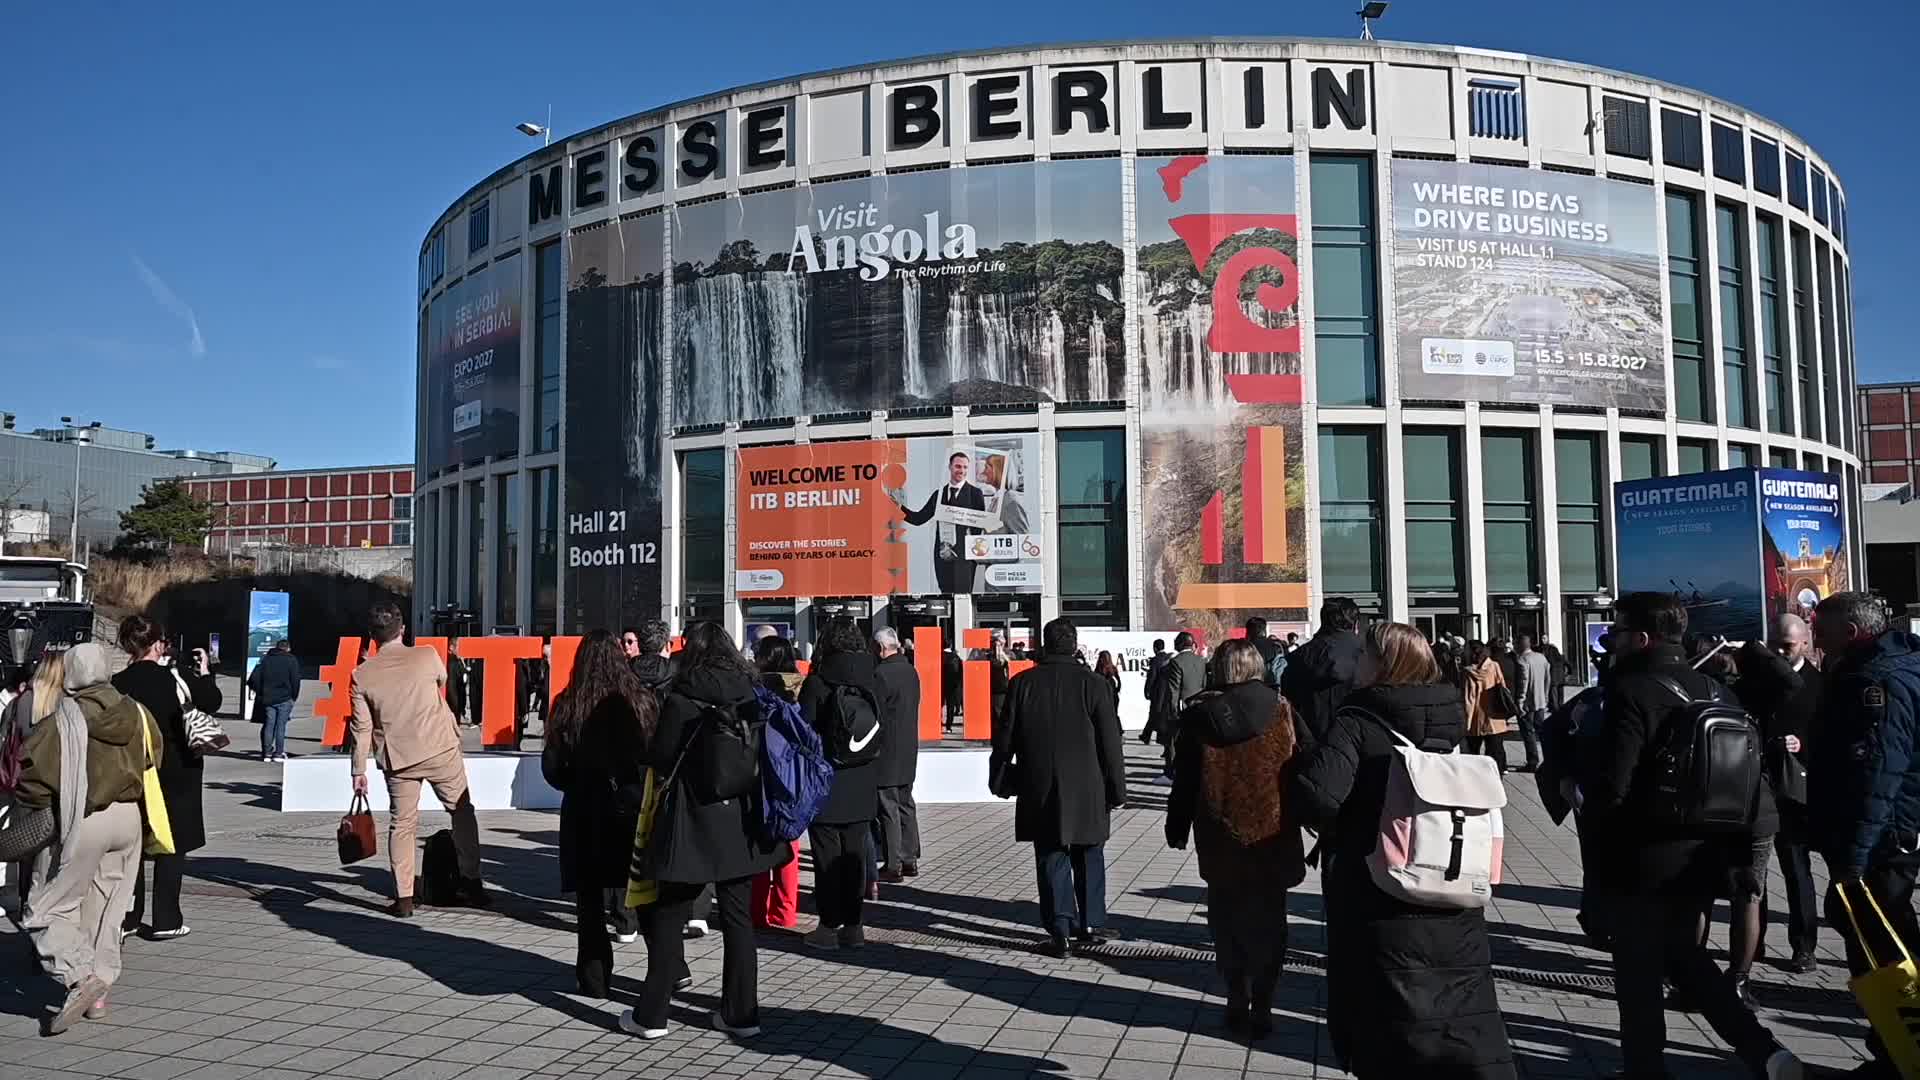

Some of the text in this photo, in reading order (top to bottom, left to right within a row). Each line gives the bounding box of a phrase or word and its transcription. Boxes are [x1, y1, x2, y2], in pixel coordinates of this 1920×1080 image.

[529, 66, 1367, 225] MESSE BERLIN
[1413, 182, 1580, 214] WHERE IDEAS
[817, 202, 879, 232] Visit
[1414, 208, 1609, 242] DRIVE BUSINESS
[784, 210, 979, 282] Angola
[1416, 237, 1455, 251] VISIT
[1458, 240, 1477, 253] US
[1480, 241, 1496, 255] AT
[1500, 243, 1537, 258] HALL
[894, 260, 1006, 279] The Rhythm of Life
[1417, 254, 1493, 270] STAND 124
[475, 289, 498, 318] YOU
[466, 306, 512, 343] SERBIA!
[454, 349, 495, 379] EXPO 2027
[1535, 349, 1565, 364] 15.5
[1579, 352, 1647, 370] 15.8.2027
[749, 464, 878, 487] WELCOME TO
[750, 488, 860, 510] ITB BERLIN!
[1621, 481, 1748, 507] GUATEMALA
[1762, 479, 1839, 500] GUATEMALA
[569, 510, 626, 535] Hall 21
[569, 542, 657, 567] Booth 112
[749, 538, 848, 550] DISCOVER THE STORIES
[994, 537, 1013, 548] ITB
[749, 552, 781, 561] BEHIND
[782, 551, 793, 560] 60
[795, 551, 824, 560] YEARS
[825, 550, 838, 559] OF
[1125, 647, 1147, 657] Visit
[1116, 653, 1151, 678] Ang
